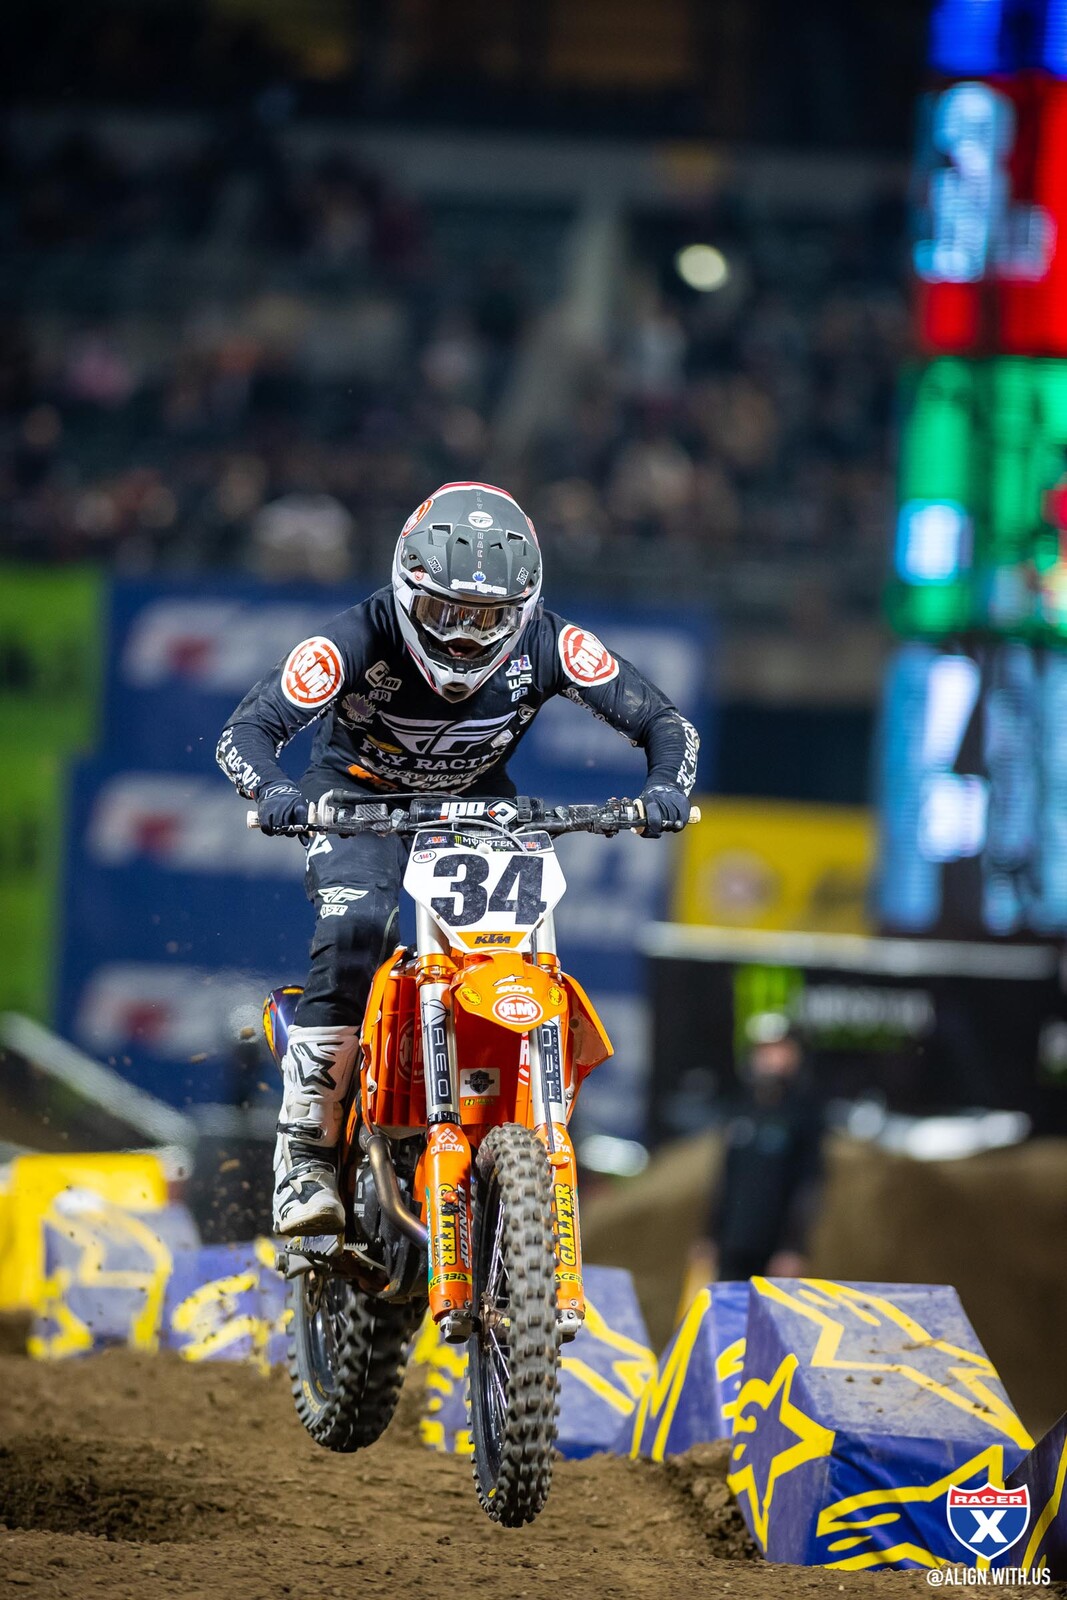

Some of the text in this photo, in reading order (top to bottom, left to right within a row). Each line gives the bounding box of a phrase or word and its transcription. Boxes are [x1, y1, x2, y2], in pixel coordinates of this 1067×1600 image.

[431, 853, 547, 926] 34
[474, 934, 511, 944] KTM
[433, 1027, 449, 1098] AEO
[430, 1143, 465, 1154] DUBYA
[457, 1183, 471, 1269] DUNLOP
[554, 1183, 577, 1267] GALFER
